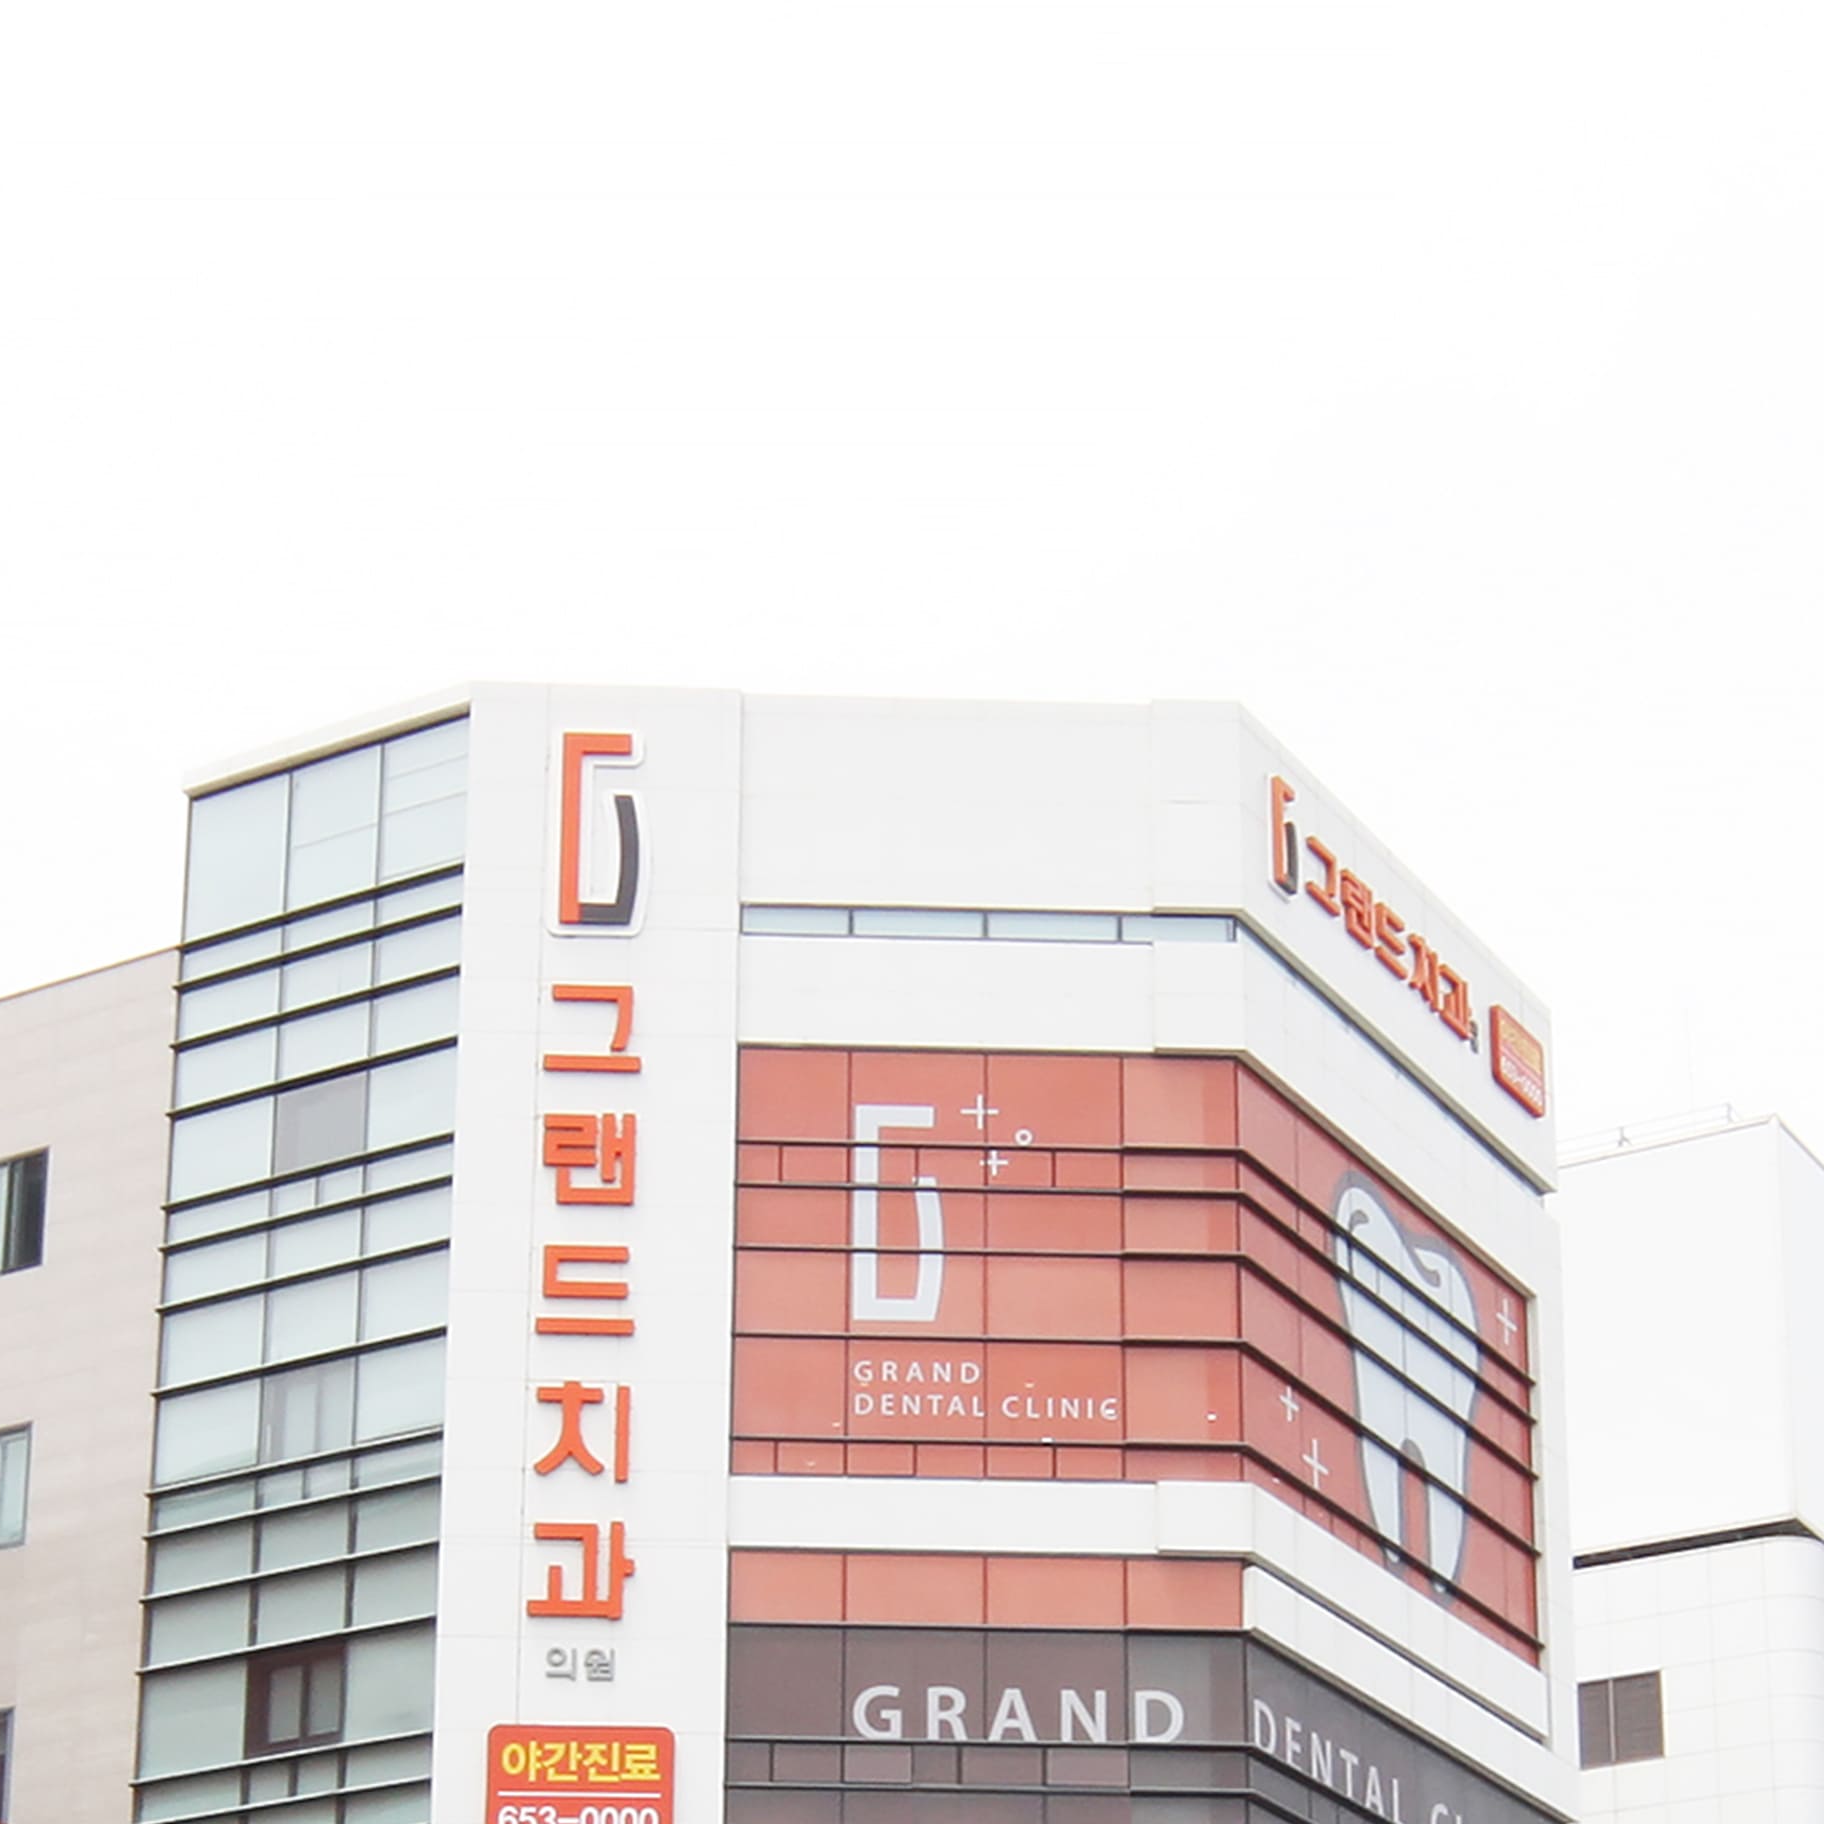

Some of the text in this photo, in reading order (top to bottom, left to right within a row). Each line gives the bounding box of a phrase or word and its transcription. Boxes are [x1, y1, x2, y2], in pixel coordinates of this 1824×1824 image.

[1305, 836, 1470, 1041] 그랜드치과
[525, 983, 642, 1622] 그랜드치과
[854, 1361, 980, 1384] GRAND
[854, 1394, 1119, 1420] DENTAL CLINIC
[546, 1648, 615, 1681] 의원
[853, 1684, 1185, 1745] GRAND
[502, 1741, 661, 1782] 야간진료
